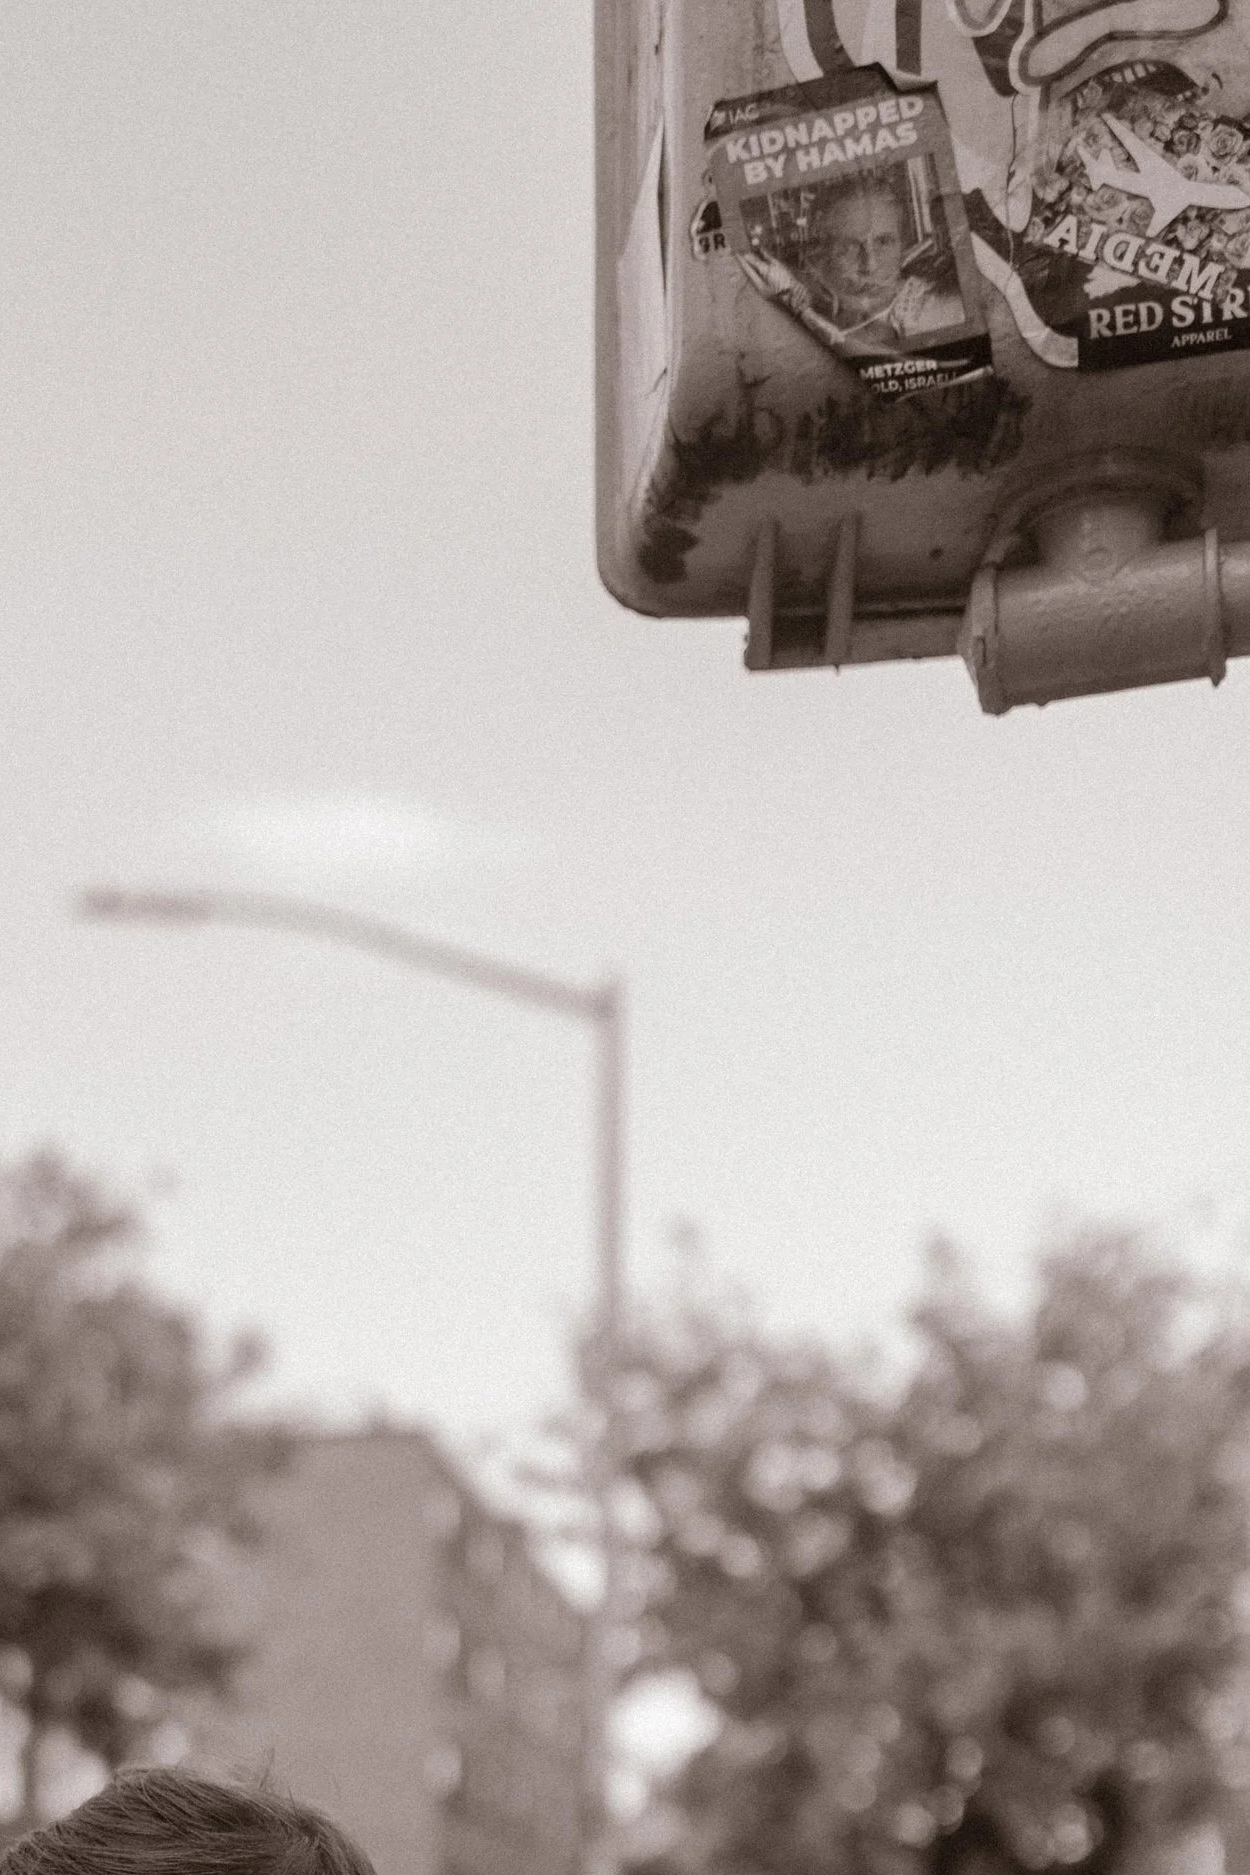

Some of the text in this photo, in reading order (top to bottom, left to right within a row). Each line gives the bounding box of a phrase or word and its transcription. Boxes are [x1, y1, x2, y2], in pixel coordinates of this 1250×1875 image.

[726, 96, 923, 163] KIDNAPPED
[744, 122, 918, 184] BY HAMAS
[1088, 287, 1250, 339] RED STR
[1171, 328, 1232, 348] APPAREL
[860, 360, 937, 380] METZGER
